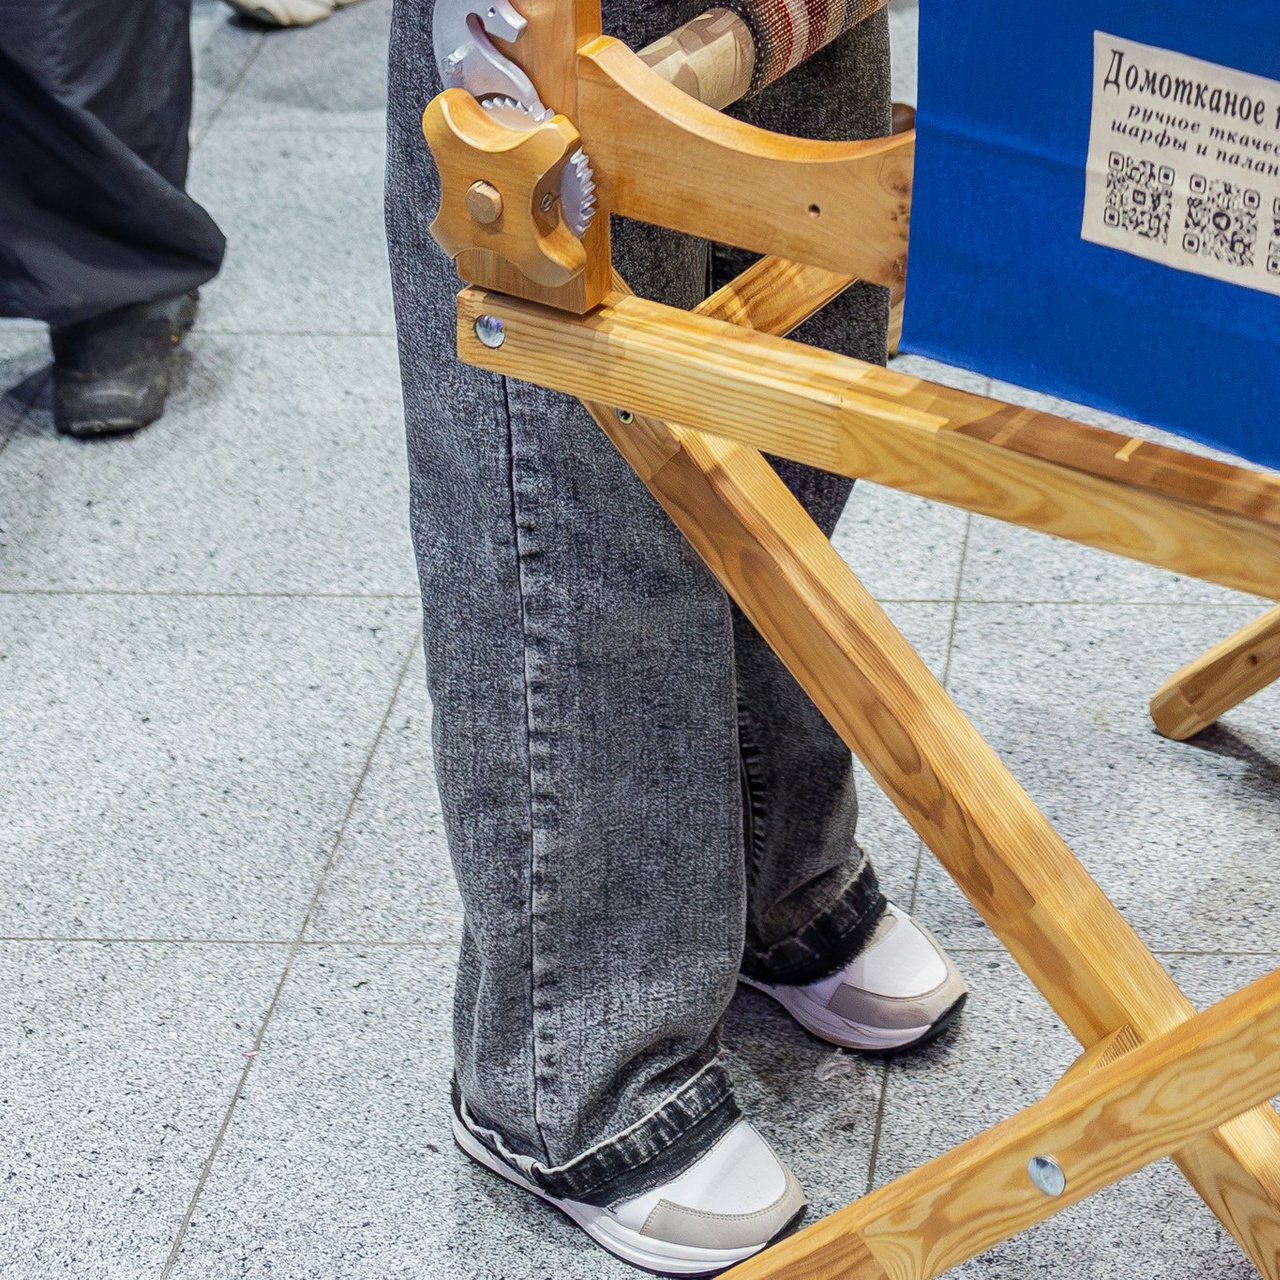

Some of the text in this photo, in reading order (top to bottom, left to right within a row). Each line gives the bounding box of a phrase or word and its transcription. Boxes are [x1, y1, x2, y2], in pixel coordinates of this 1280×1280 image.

[1103, 48, 1266, 126] Домотканое
[1111, 119, 1188, 149] шарфы
[1196, 143, 1208, 156] и
[1127, 105, 1201, 134] ручное
